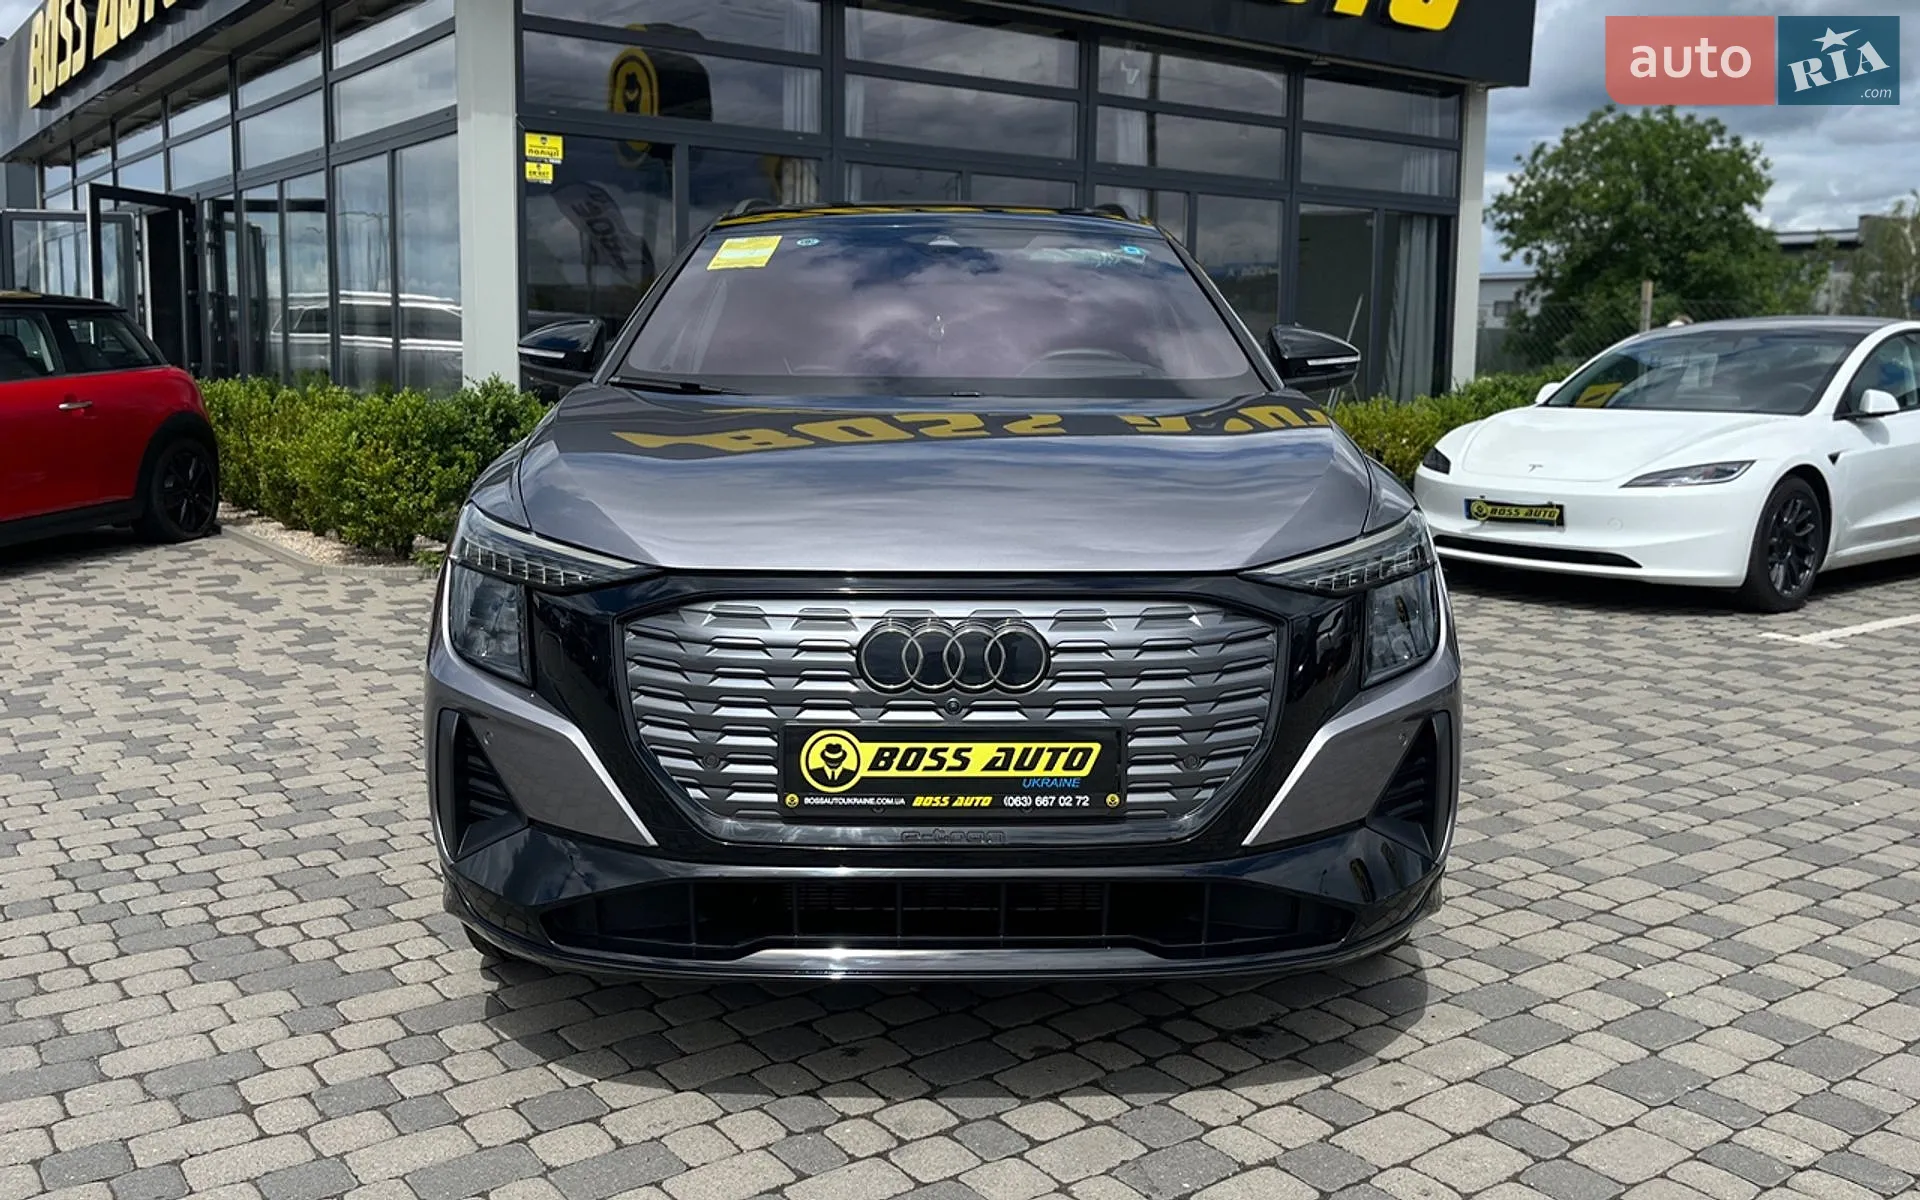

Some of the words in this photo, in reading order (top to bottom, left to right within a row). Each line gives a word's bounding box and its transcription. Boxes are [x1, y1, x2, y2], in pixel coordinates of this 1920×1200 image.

[867, 747, 973, 772] BOSS
[980, 747, 1094, 772] AUTO
[1022, 777, 1081, 789] UKRAINE
[804, 797, 906, 806] BOSSAUTOUKRAINE.COM.UA
[912, 796, 950, 807] BOSS
[951, 796, 993, 807] AUTO
[1003, 795, 1032, 807] (063)
[1034, 795, 1056, 807] 667
[1058, 795, 1073, 807] 02
[1075, 795, 1090, 807] 72
